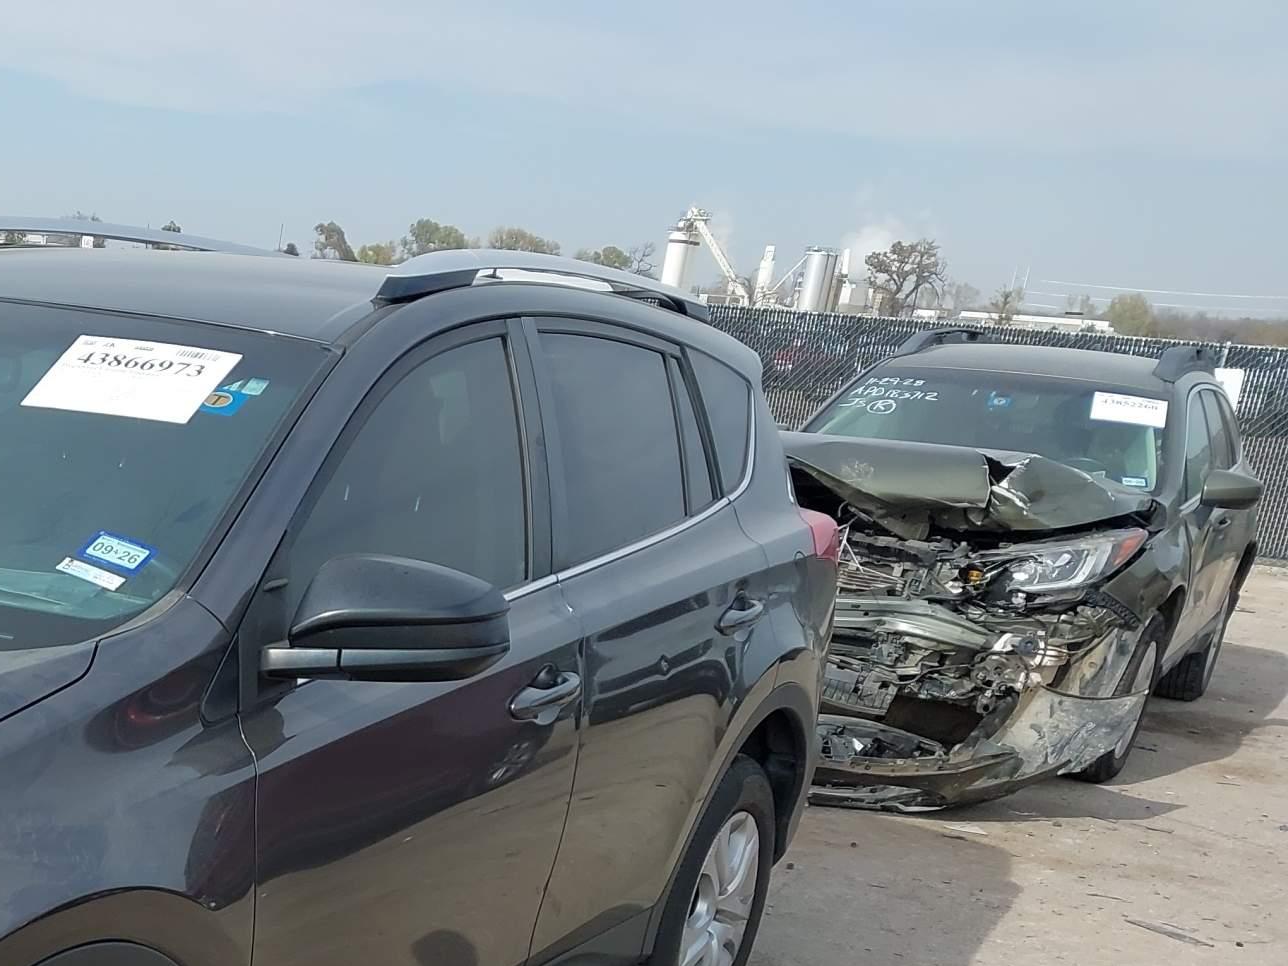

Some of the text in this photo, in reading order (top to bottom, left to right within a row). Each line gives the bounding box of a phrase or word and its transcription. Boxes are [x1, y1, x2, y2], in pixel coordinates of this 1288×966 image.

[77, 350, 206, 378] 43866973
[92, 541, 114, 555] 09
[116, 550, 141, 565] 26
